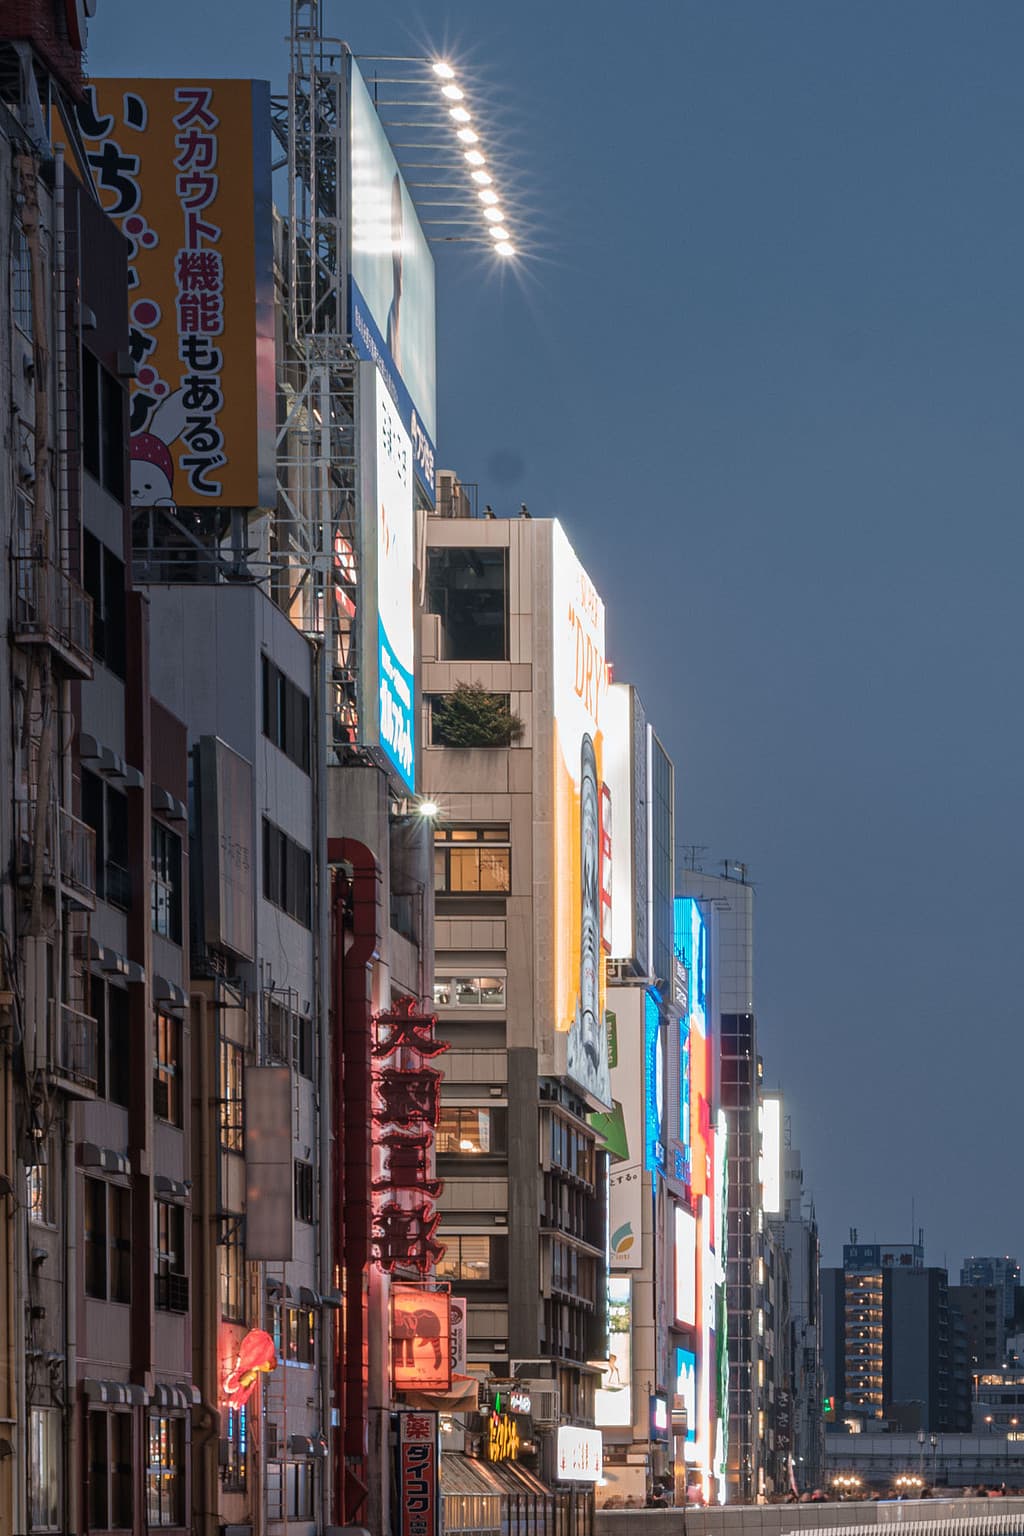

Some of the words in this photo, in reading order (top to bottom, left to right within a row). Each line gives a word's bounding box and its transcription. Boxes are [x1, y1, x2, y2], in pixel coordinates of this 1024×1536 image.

[174, 87, 225, 497] スカウト機能もあるで
[406, 1443, 431, 1513] ダイコク
